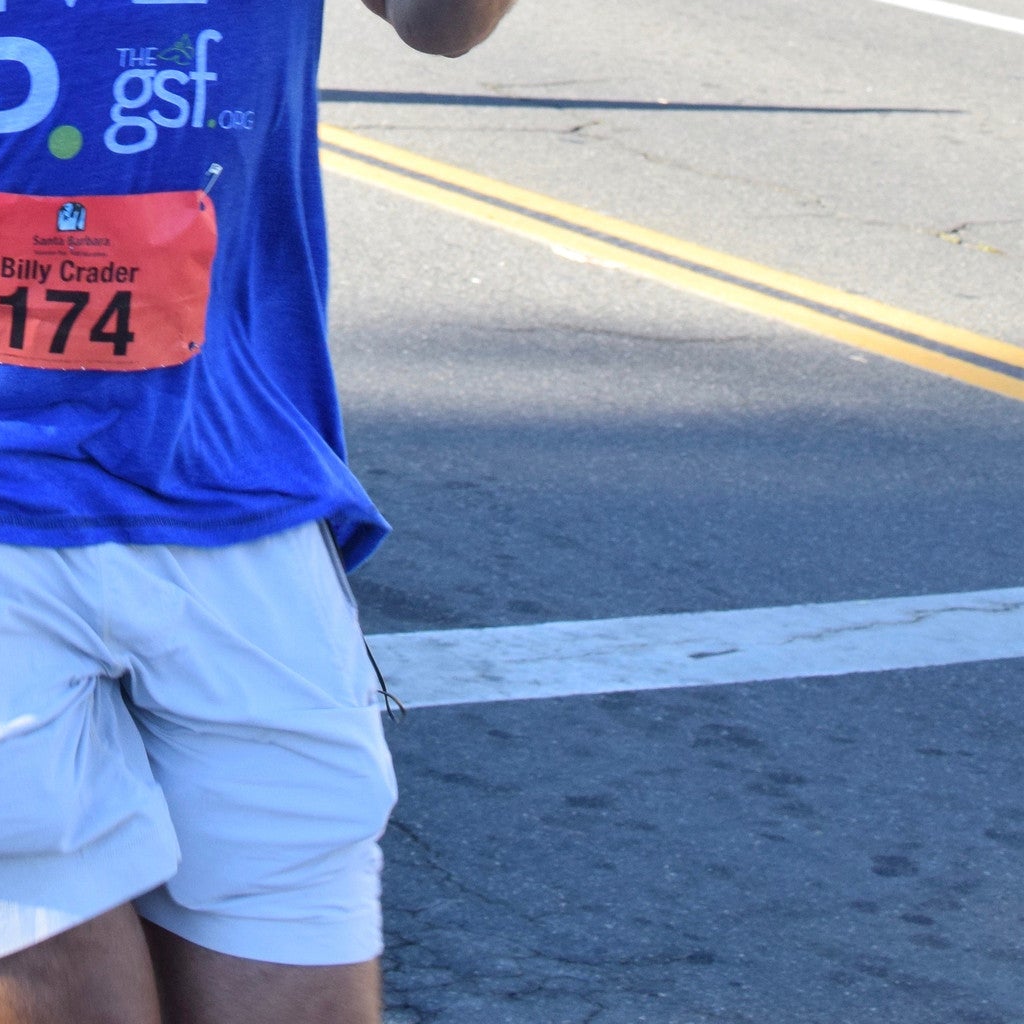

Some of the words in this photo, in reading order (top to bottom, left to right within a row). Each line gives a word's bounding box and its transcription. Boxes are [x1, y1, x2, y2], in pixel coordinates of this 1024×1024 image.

[115, 46, 159, 67] THE
[0, 256, 51, 283] Billy
[59, 259, 140, 284] Crader
